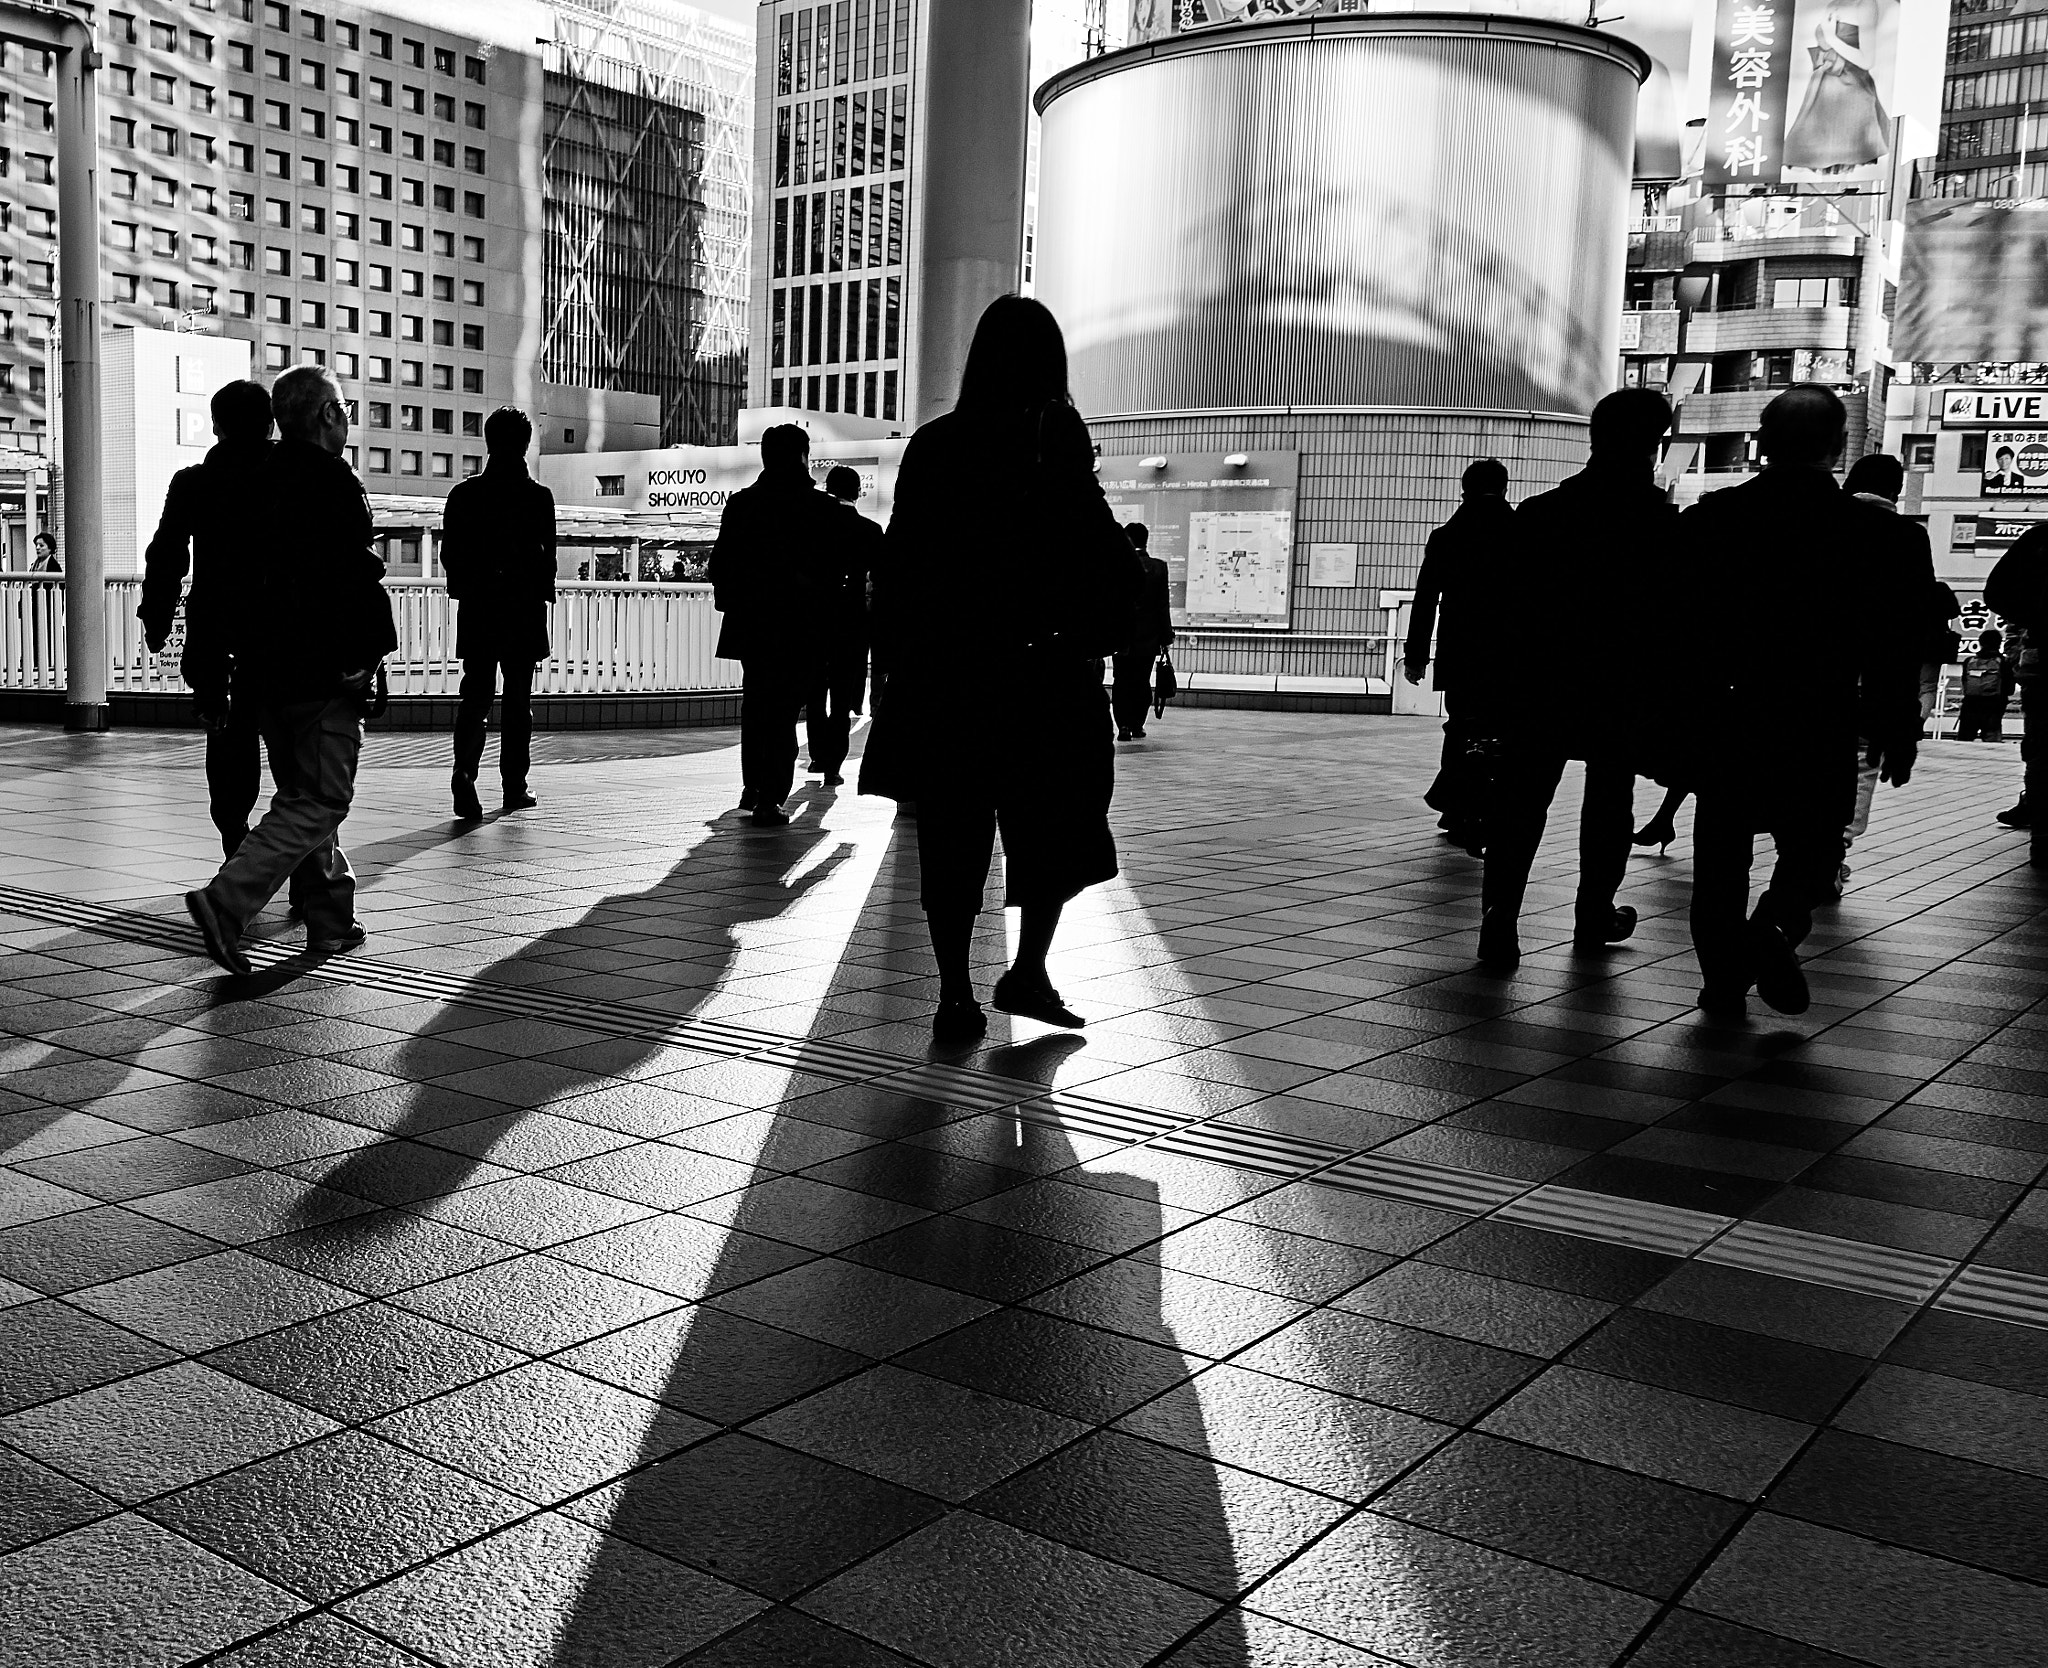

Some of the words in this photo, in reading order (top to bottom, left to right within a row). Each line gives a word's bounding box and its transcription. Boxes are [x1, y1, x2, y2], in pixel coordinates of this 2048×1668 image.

[1723, 0, 1775, 177] 美容外科
[1975, 396, 2042, 419] LiVE
[186, 412, 204, 441] P
[648, 469, 706, 485] KOKUYO
[160, 660, 179, 668] Tokyo
